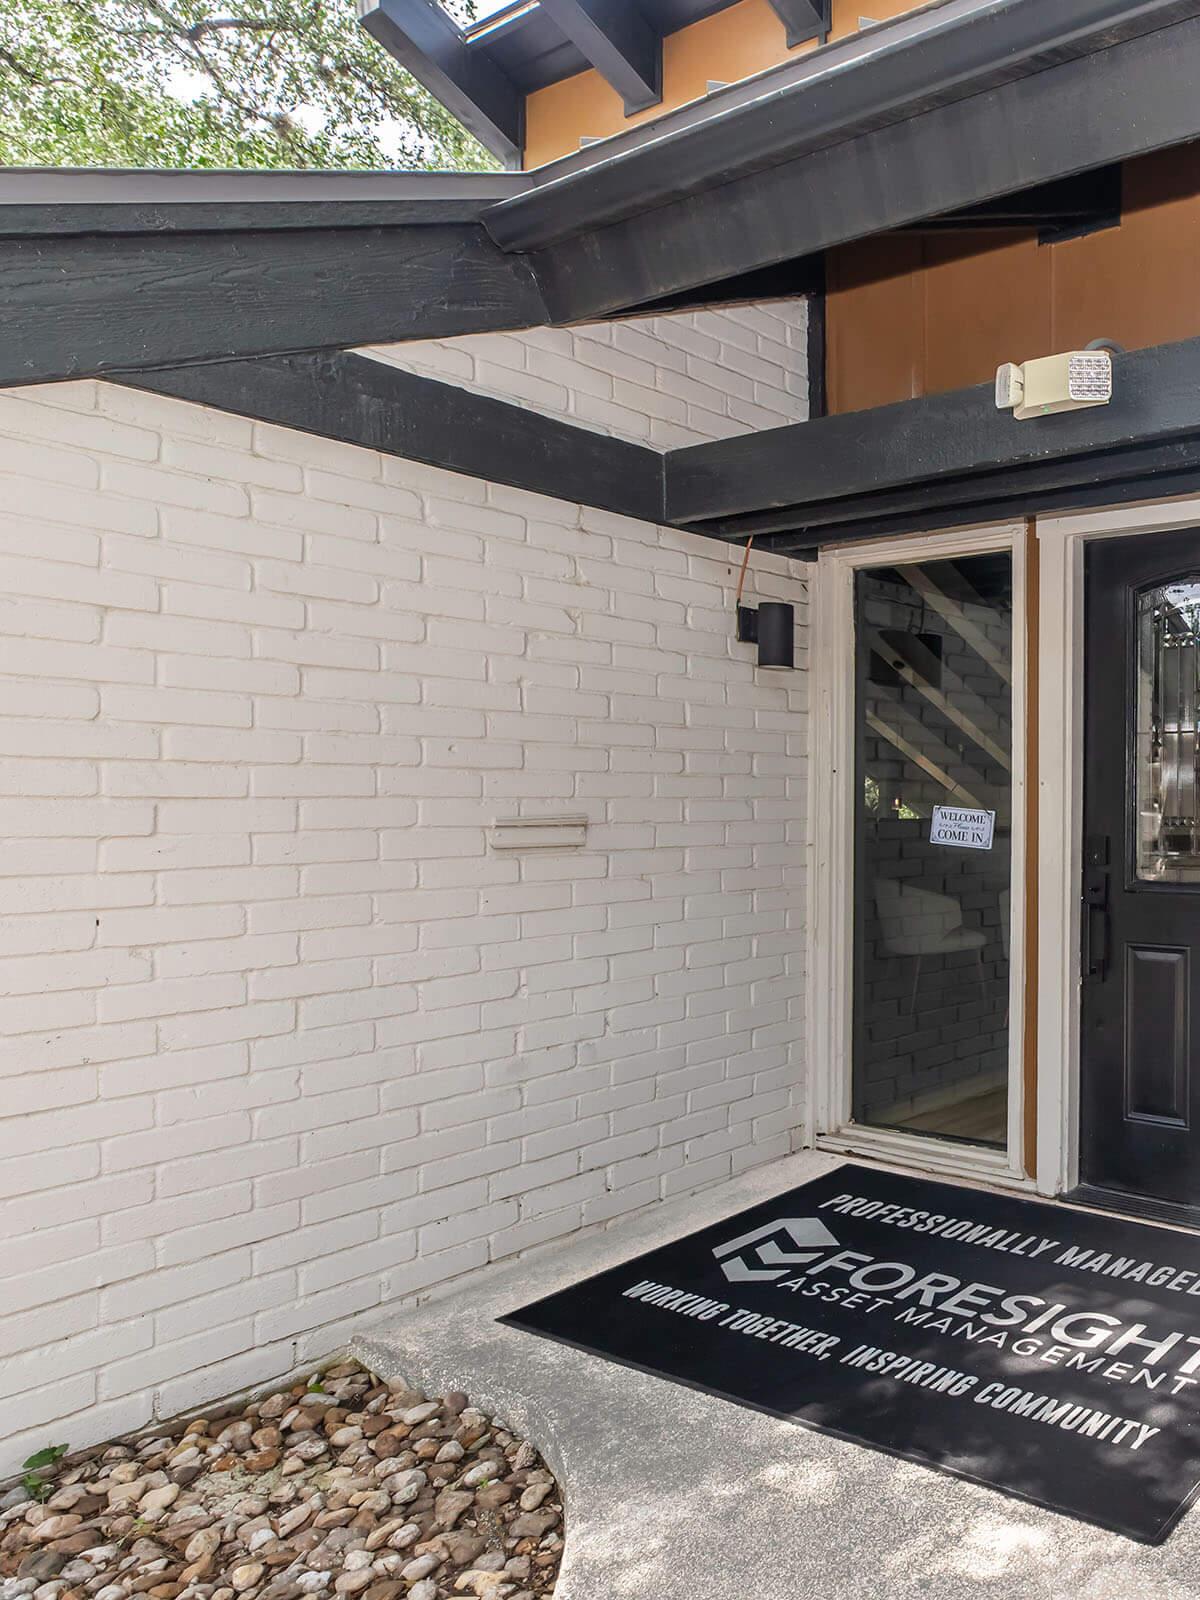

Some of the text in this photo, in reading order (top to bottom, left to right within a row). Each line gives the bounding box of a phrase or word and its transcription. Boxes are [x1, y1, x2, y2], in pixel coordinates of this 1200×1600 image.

[937, 829, 983, 843] COME IN
[940, 811, 986, 825] WELCOME
[818, 1193, 1058, 1257] PROFESSIONALLY
[622, 1280, 1161, 1450] WORKING TOGETHER, INSPIRING COMMUNITY
[776, 1277, 1199, 1395] ASSET MANAGEMENT
